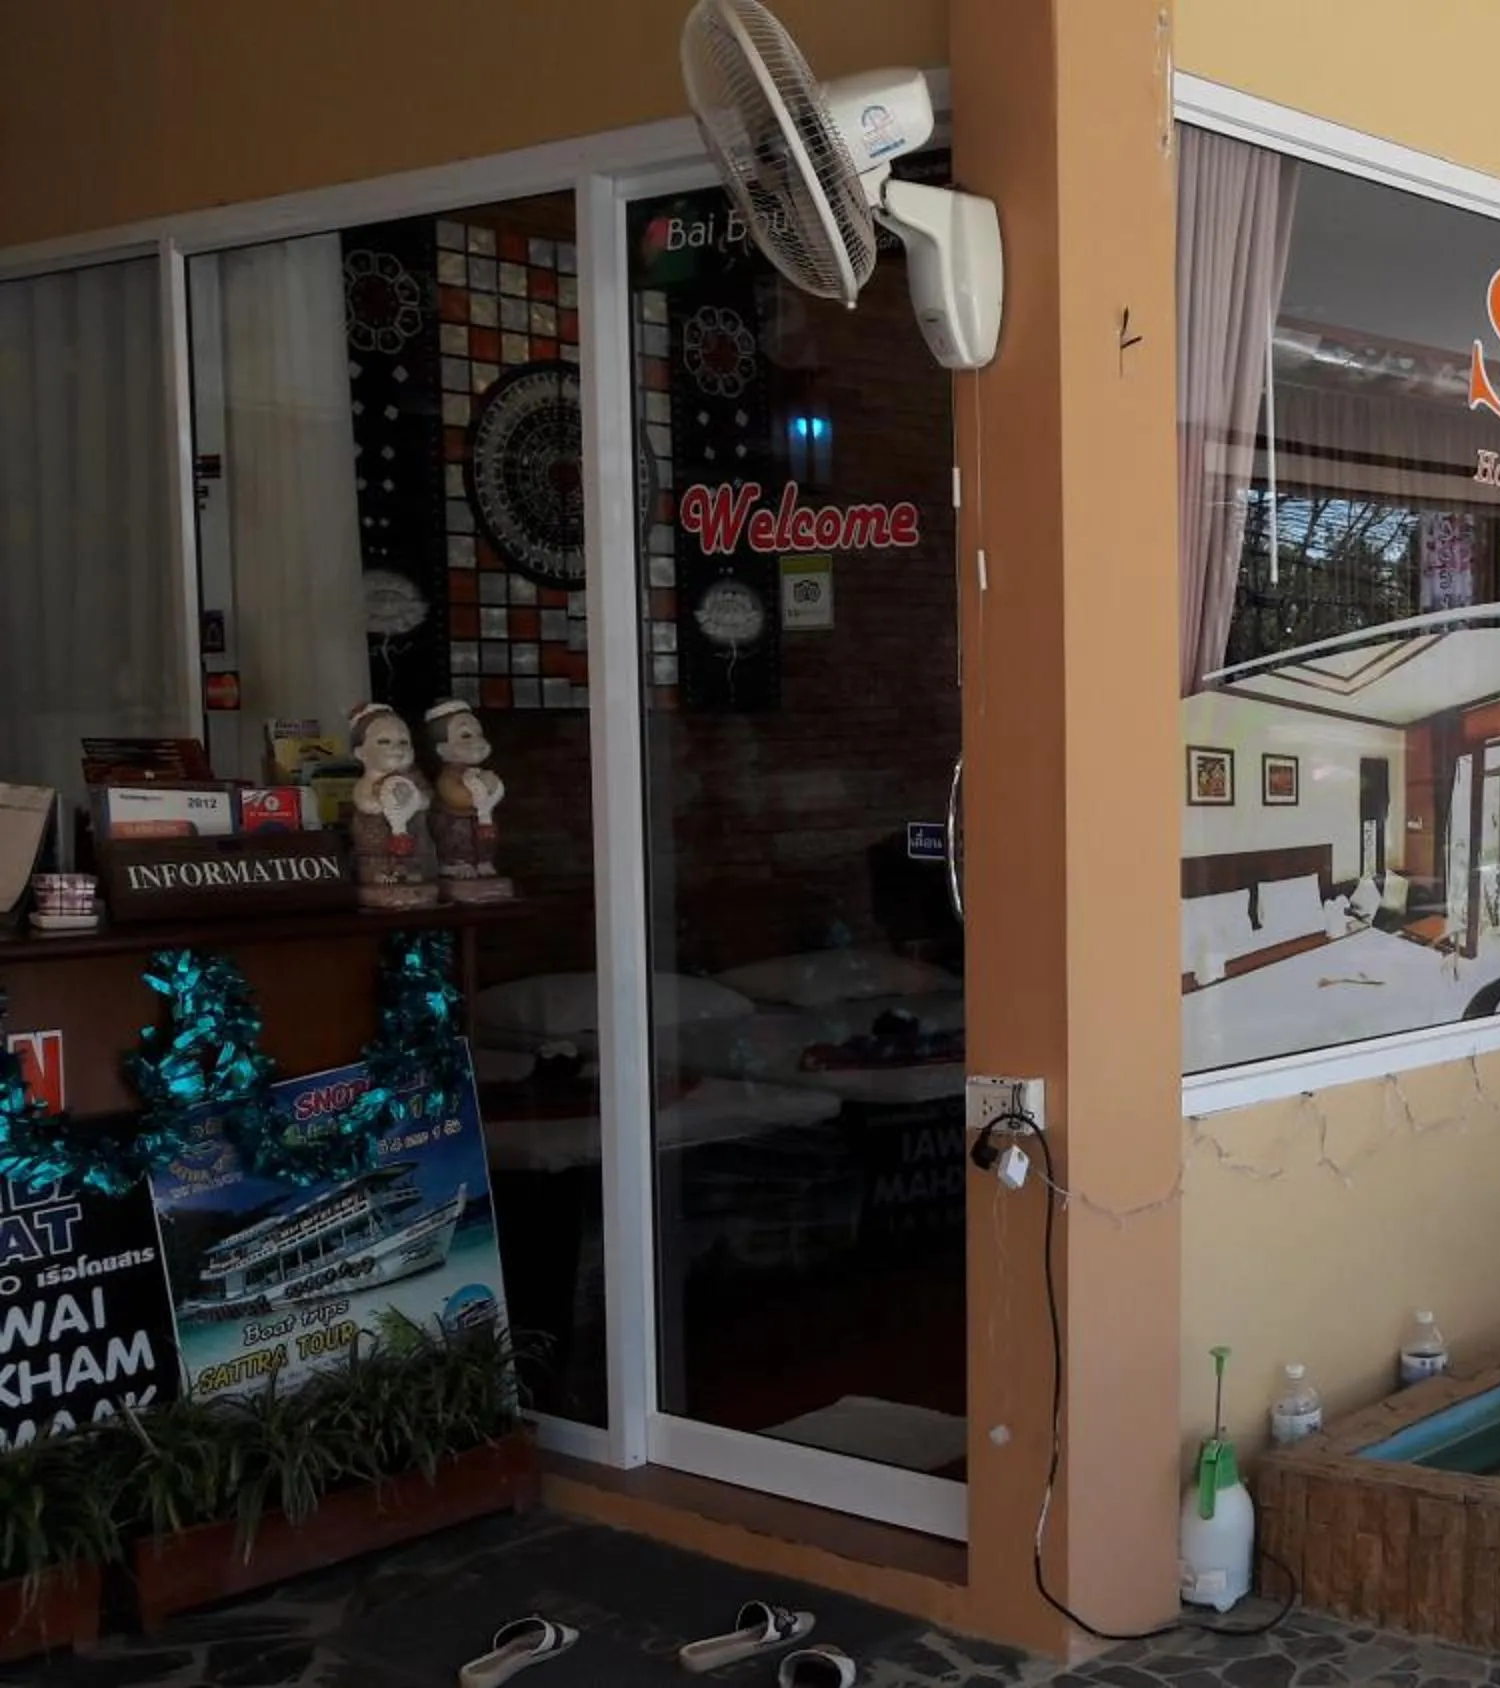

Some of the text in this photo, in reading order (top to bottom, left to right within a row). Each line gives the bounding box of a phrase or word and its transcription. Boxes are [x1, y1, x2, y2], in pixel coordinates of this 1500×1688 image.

[666, 211, 715, 251] Bai
[680, 480, 920, 555] Welcome
[127, 856, 341, 890] INFORMATION
[243, 1318, 295, 1346] Boat
[301, 1298, 349, 1328] trips
[296, 1320, 358, 1360] TOUR
